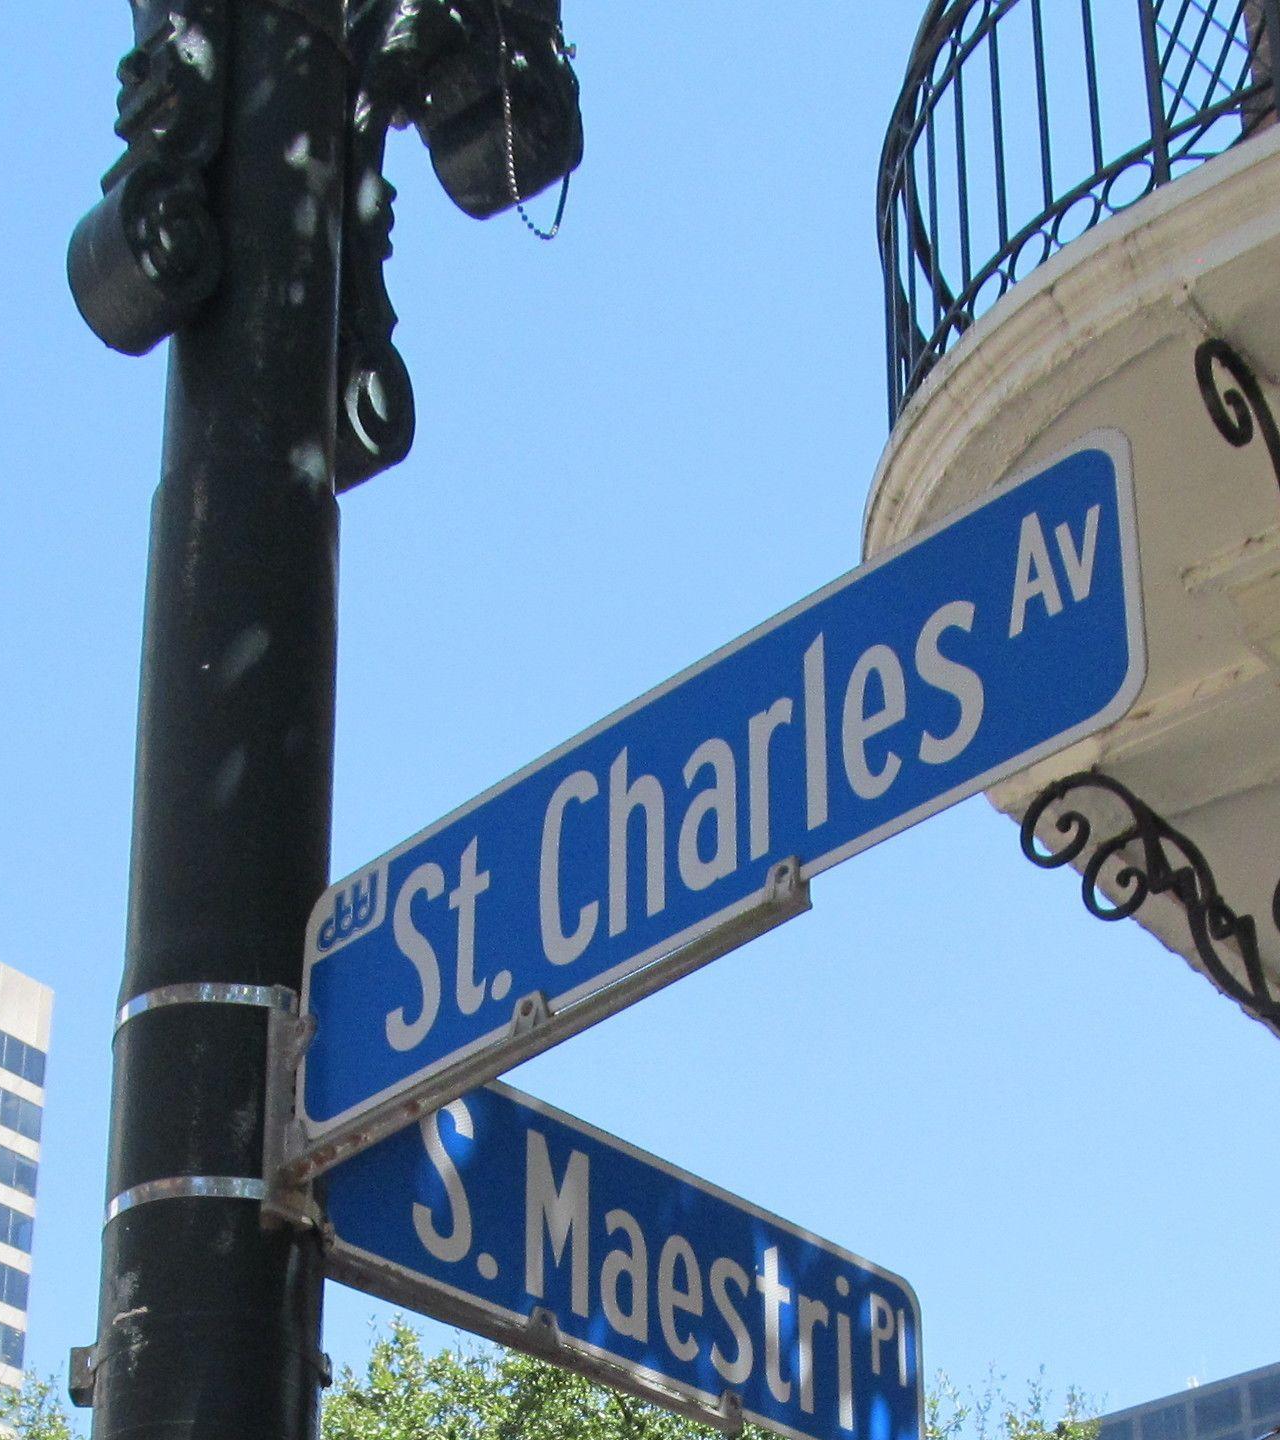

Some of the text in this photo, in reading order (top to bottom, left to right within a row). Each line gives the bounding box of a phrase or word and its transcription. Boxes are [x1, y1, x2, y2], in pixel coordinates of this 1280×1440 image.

[386, 504, 1101, 1052] St. Charles Av
[412, 1097, 499, 1280] S.
[525, 1128, 854, 1431] Maestri
